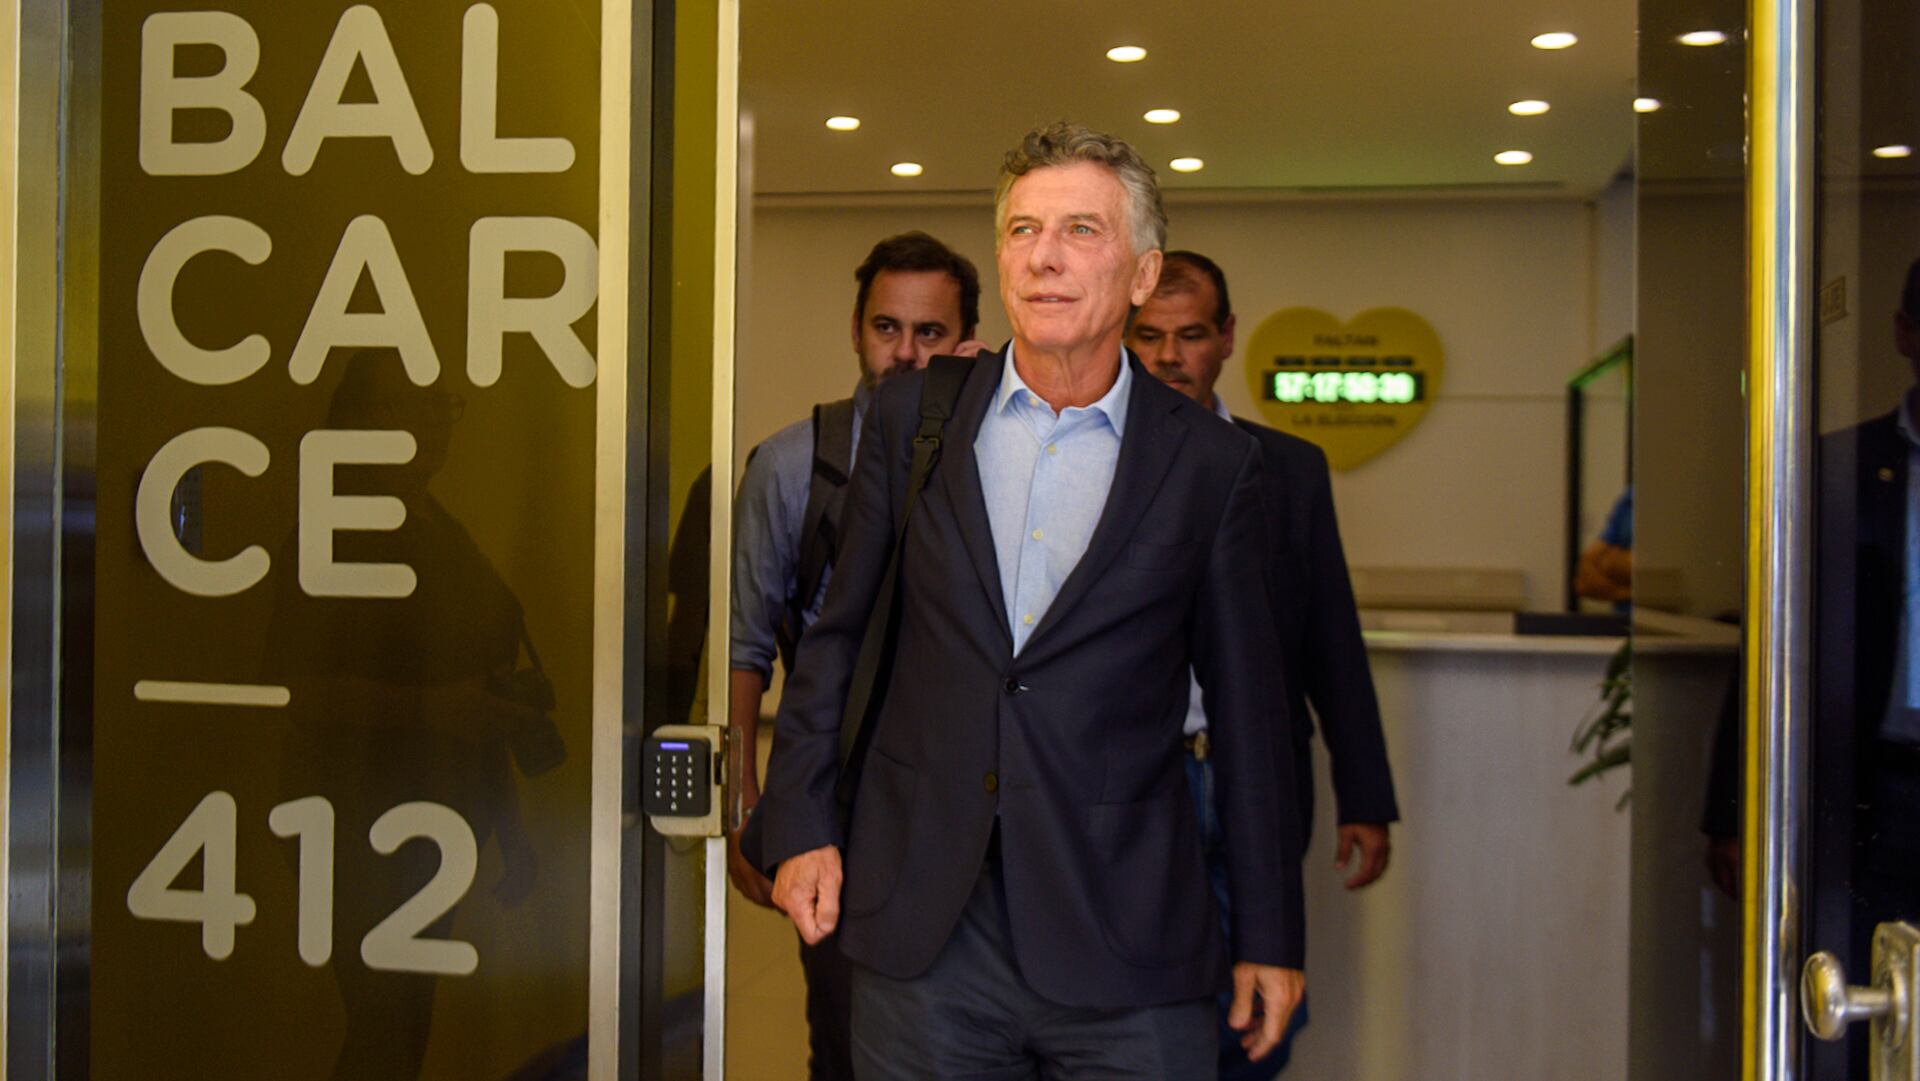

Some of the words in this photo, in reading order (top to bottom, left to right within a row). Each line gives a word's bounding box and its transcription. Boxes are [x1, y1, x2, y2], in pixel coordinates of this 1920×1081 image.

[139, 3, 575, 175] BAL
[137, 214, 598, 388] CAR
[136, 427, 417, 597] CE
[127, 792, 478, 975] 412
